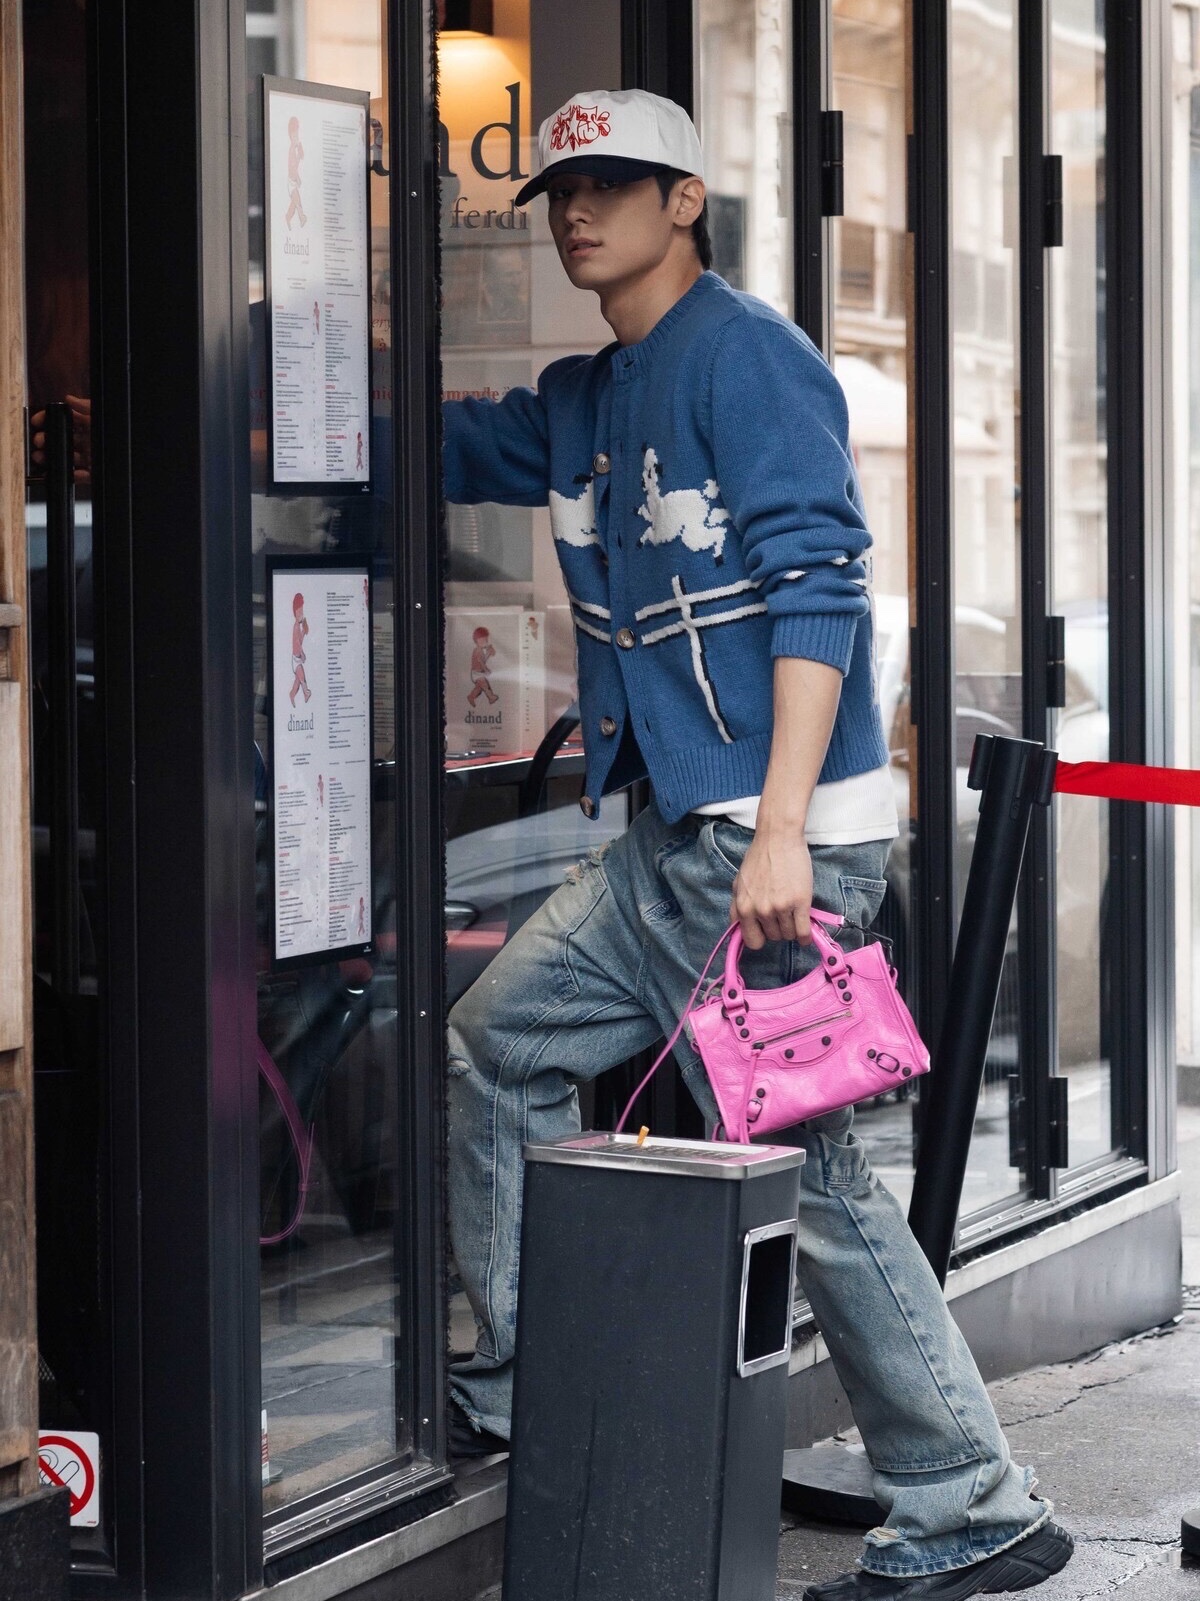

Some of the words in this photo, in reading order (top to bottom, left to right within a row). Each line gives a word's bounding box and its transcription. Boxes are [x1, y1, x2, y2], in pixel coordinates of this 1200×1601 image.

[284, 237, 310, 256] dinand
[287, 712, 314, 732] dinand
[464, 711, 502, 725] dinand
